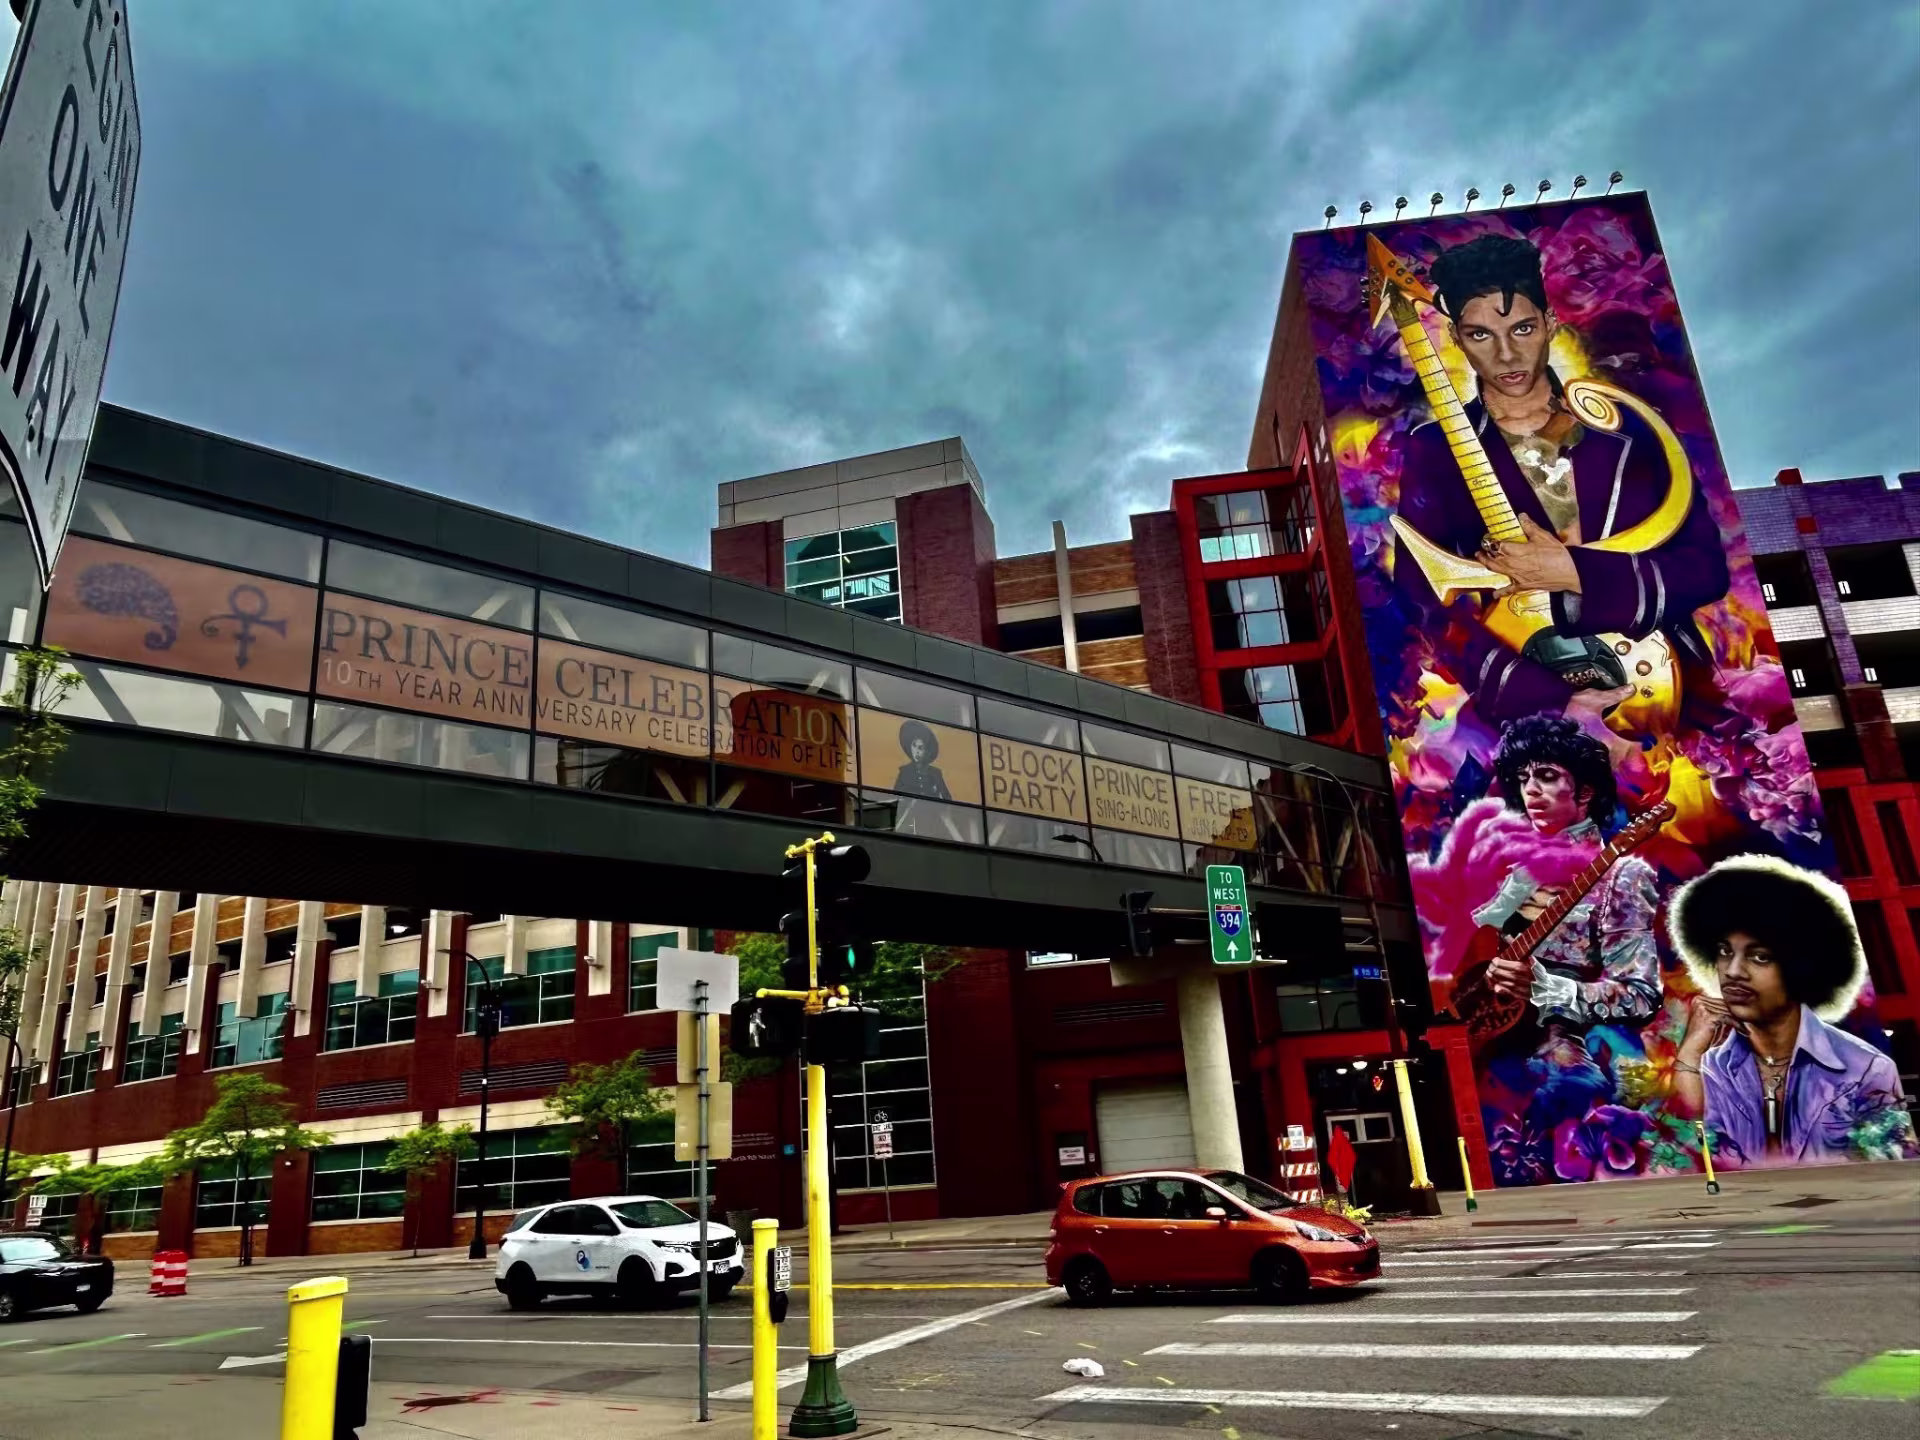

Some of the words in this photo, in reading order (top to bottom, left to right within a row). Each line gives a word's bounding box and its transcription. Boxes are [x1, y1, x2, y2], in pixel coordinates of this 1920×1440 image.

[49, 84, 106, 339] ONE
[0, 229, 76, 484] WAY
[320, 607, 529, 689] PRINCE
[323, 657, 382, 690] 10TH
[395, 670, 462, 706] YEAR
[791, 744, 815, 764] OF
[819, 749, 853, 773] LIFE
[990, 743, 1076, 786] BLOCK
[1091, 765, 1169, 805] PRINCE
[991, 774, 1077, 817] PARTY
[1095, 796, 1171, 830] SING-ALONG
[1187, 785, 1243, 820] FREE
[1213, 887, 1241, 900] WEST
[1219, 871, 1233, 884] TO
[1219, 912, 1241, 928] 394
